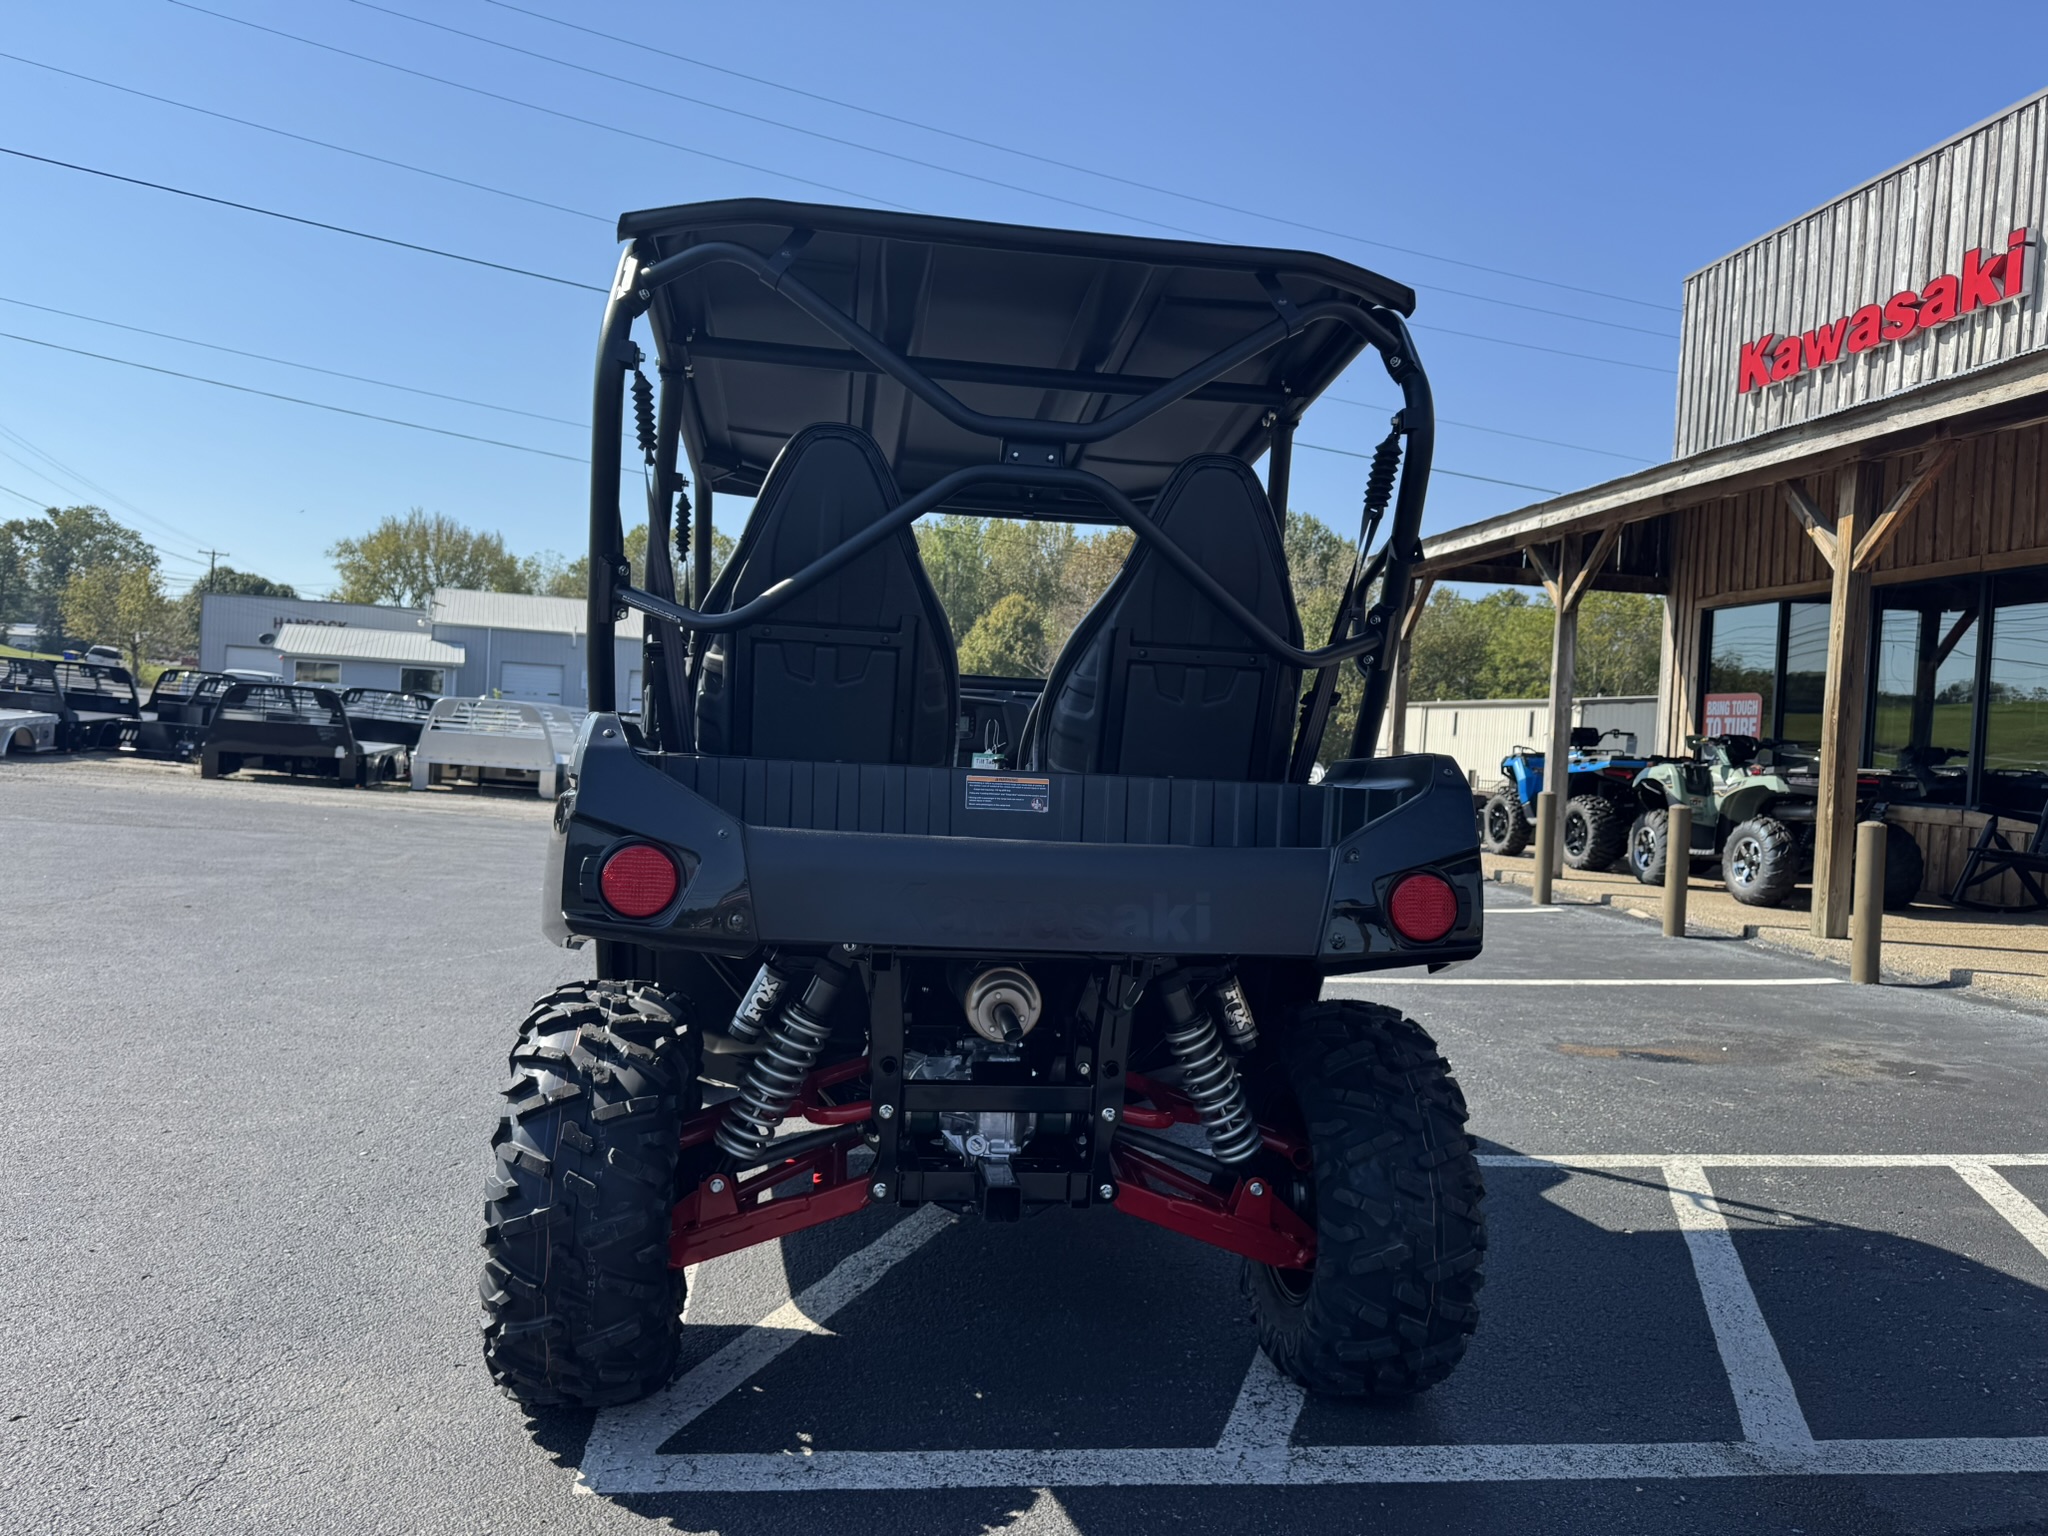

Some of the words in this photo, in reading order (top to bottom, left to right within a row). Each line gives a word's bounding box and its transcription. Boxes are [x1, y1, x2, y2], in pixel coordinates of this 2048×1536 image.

[1739, 227, 2032, 394] Kawasaki
[1706, 717, 1721, 738] TO
[1707, 700, 1730, 716] BRING
[1732, 700, 1758, 715] TOUGH
[744, 976, 779, 1022] FOX
[1224, 986, 1252, 1030] FOX
